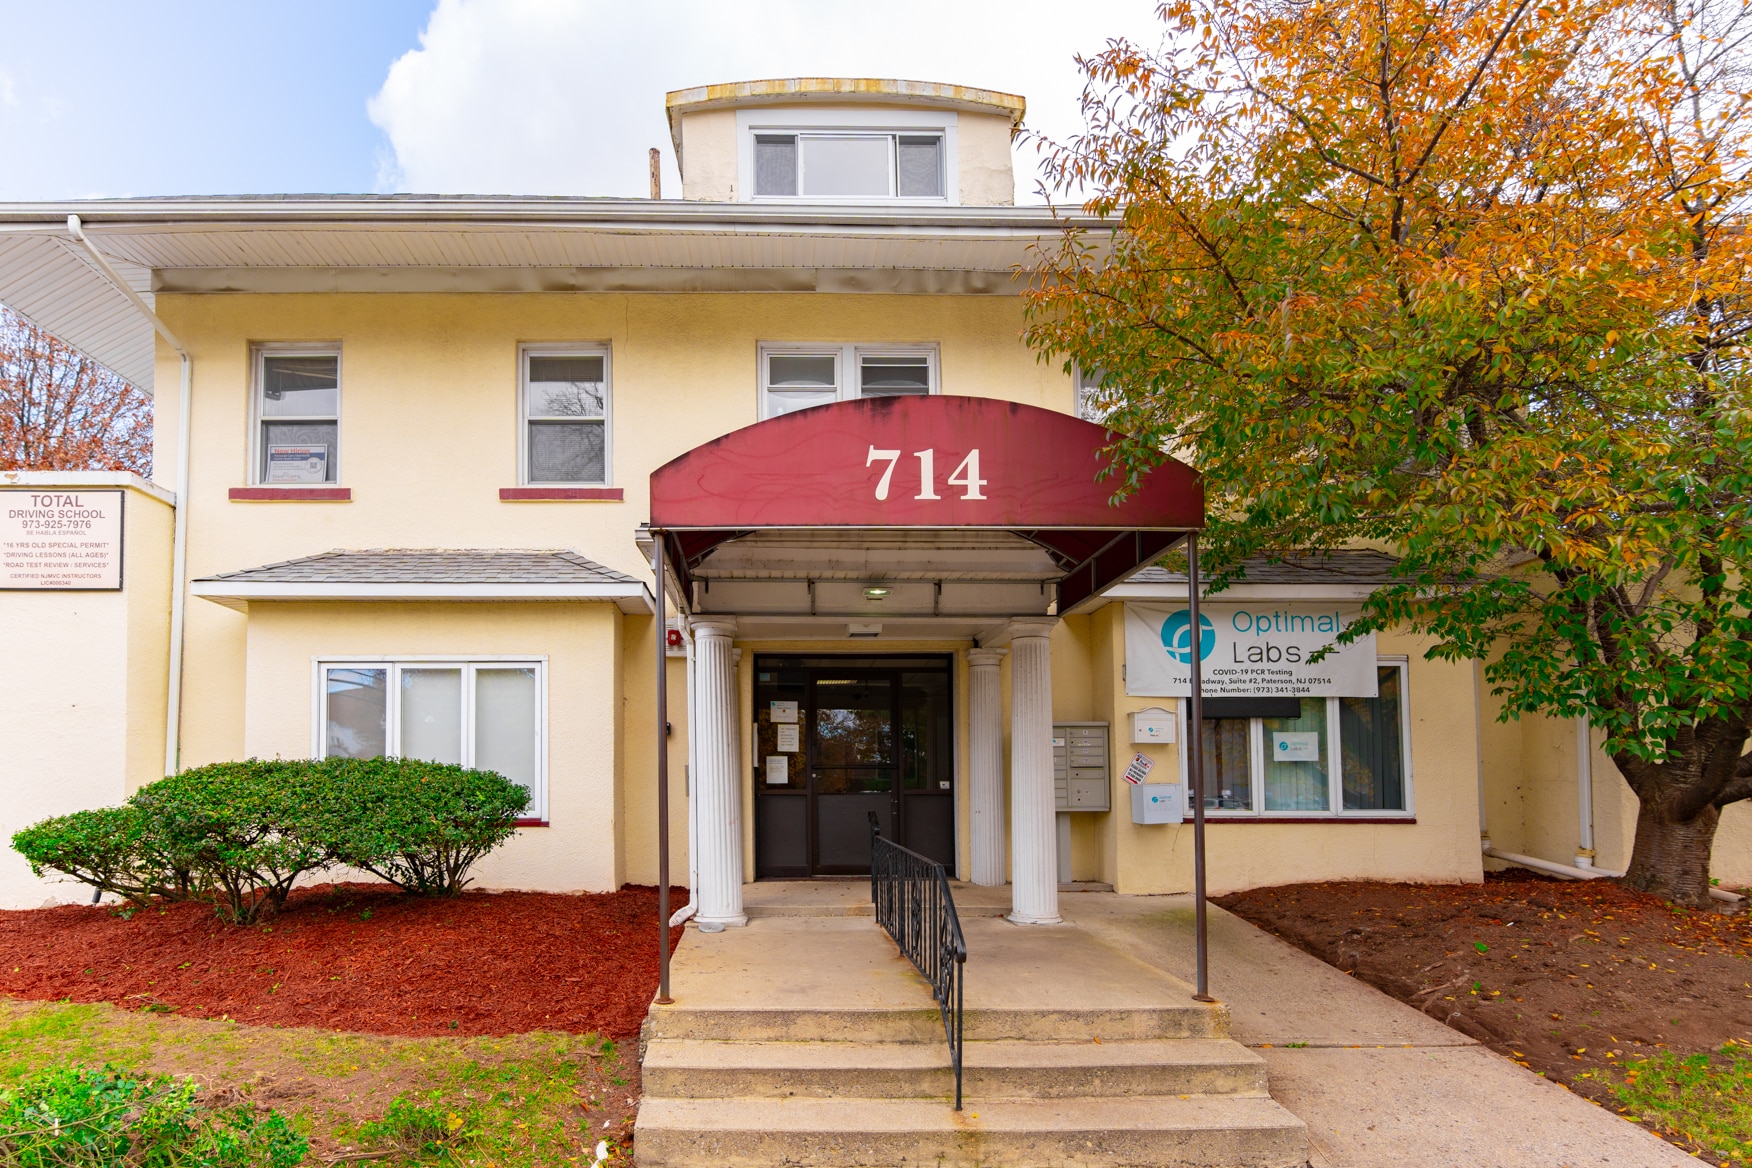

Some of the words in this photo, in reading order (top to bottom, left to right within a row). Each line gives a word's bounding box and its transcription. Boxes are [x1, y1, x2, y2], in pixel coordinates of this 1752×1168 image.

[866, 445, 988, 501] 714
[31, 495, 84, 507] TOTAL
[8, 509, 55, 519] DRIVING
[58, 509, 106, 519] SCHOOL
[22, 520, 92, 529] 973-925-7976
[1232, 610, 1340, 637] Optimal
[1233, 641, 1302, 663] Labs
[1212, 668, 1249, 676] COVID-19
[1250, 668, 1266, 676] PCR
[1267, 668, 1293, 677] Testing
[1189, 677, 1227, 686] adway,
[1248, 677, 1260, 685] #2,
[1261, 677, 1295, 685] Paterson,
[1308, 677, 1332, 685] 07514
